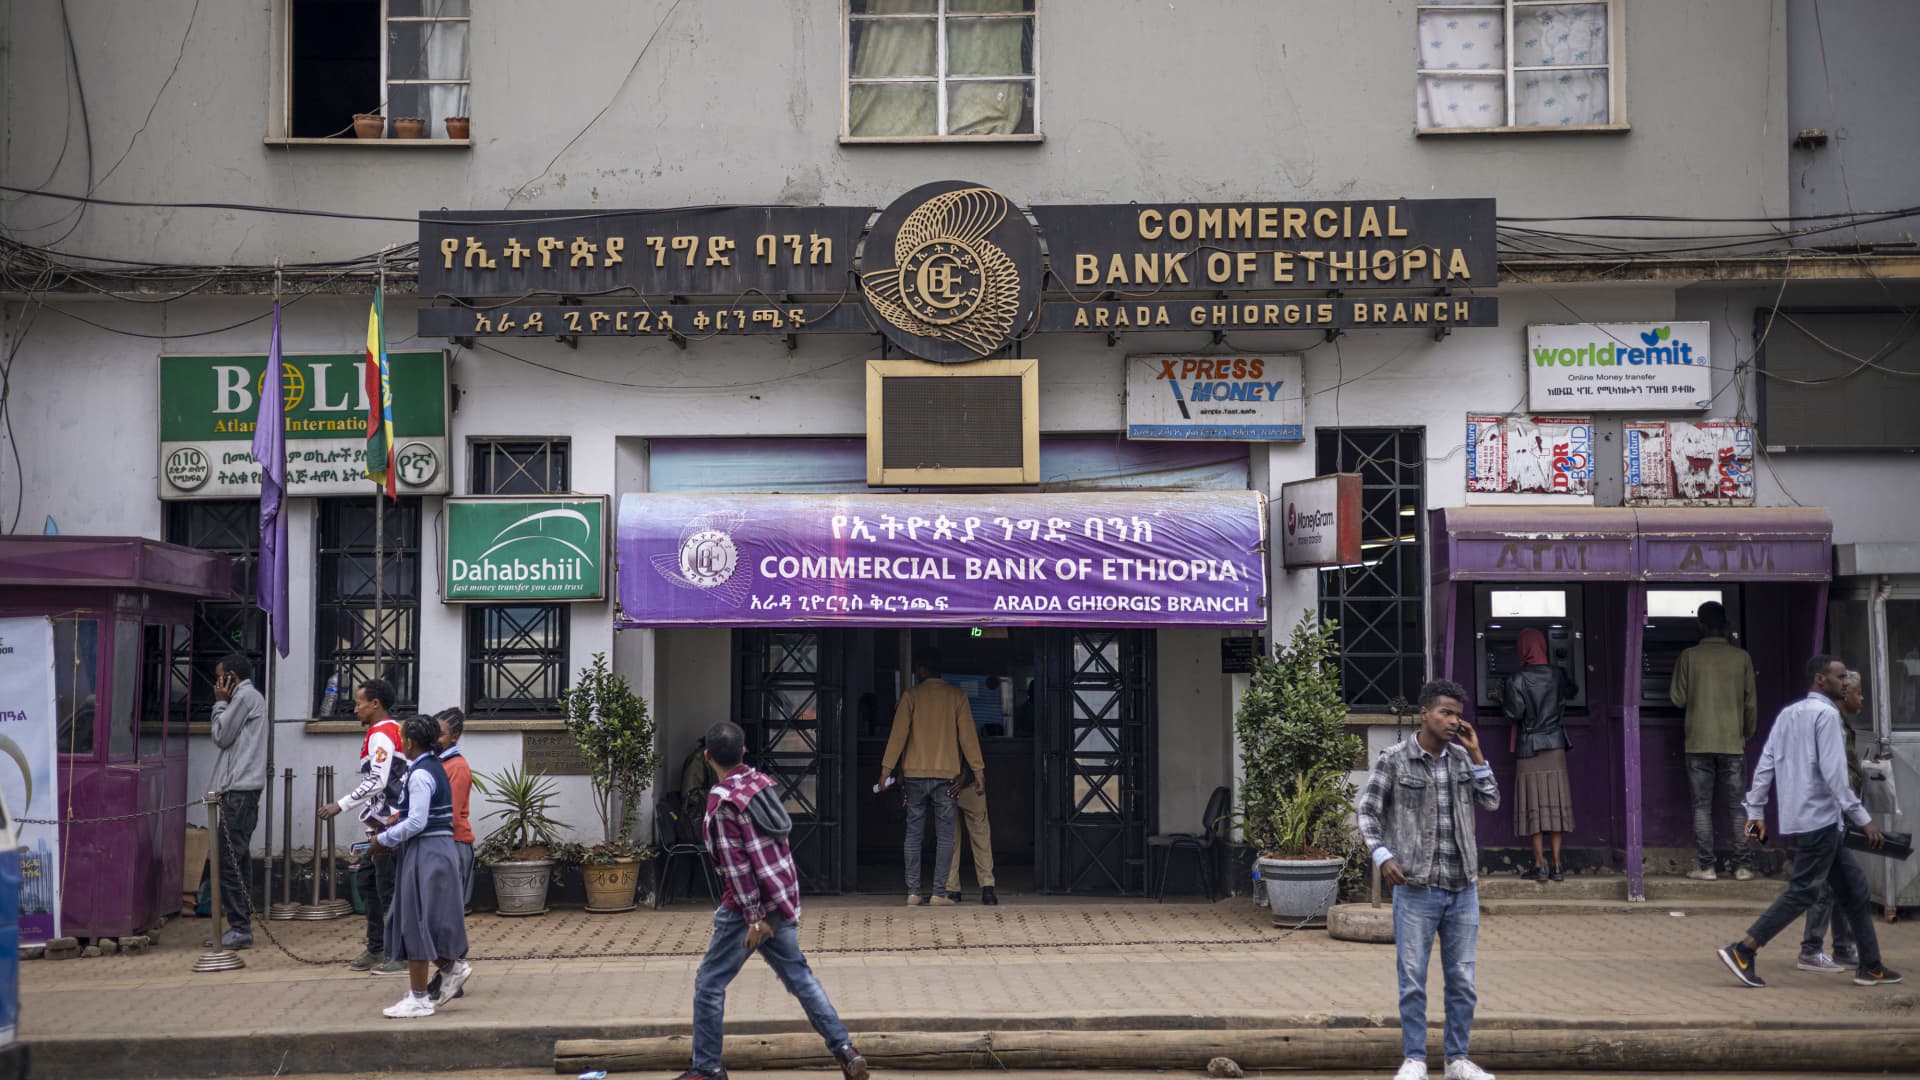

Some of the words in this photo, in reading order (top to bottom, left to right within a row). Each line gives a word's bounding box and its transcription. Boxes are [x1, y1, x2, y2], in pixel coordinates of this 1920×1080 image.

[1138, 205, 1408, 241] COMMERCIAL
[440, 236, 626, 270] የኢትዮጵያ
[646, 235, 736, 267] ንግድ
[755, 233, 833, 266] ባንክ
[1075, 252, 1189, 287] BANK
[1207, 251, 1258, 285] OF
[1273, 247, 1472, 284] ETHIOPIA
[474, 311, 544, 334] አራዳ
[562, 310, 673, 333] ጊዮርጊስ
[693, 308, 806, 331] ቅርንጫፍ
[1074, 306, 1171, 328] ARADA
[1190, 303, 1334, 326] GHIORGIS
[1353, 301, 1470, 323] BRANCH
[1532, 339, 1693, 367] worldremit
[1156, 358, 1265, 380] XPRESS
[1567, 373, 1595, 383] Online
[1595, 373, 1624, 384] Money
[1625, 372, 1657, 382] transfer
[1190, 380, 1285, 402] MONEY
[213, 417, 257, 434] Atlan
[285, 415, 368, 433] Internatio
[1630, 431, 1639, 458] future
[831, 513, 981, 543] የኢትዮጵያ
[993, 516, 1072, 543] ንግድ
[1084, 515, 1153, 543] ባንክ
[1297, 509, 1335, 532] MoneyGram
[759, 556, 956, 580] COMMERCIAL
[965, 557, 1046, 580] BANK
[1055, 558, 1092, 581] OF
[1103, 558, 1239, 582] ETHIOPIA
[1497, 542, 1588, 570] ATM
[1679, 544, 1775, 571] ATM
[452, 557, 583, 582] Dahabshiil
[453, 584, 469, 593] fast
[470, 585, 497, 593] money
[497, 583, 530, 593] transfer
[531, 585, 546, 593] you
[564, 583, 583, 591] trust
[750, 594, 792, 611] አራዳ
[870, 593, 949, 612] ቅርንጫፍ
[993, 595, 1062, 612] ARADA
[1067, 595, 1162, 613] GHIORGIS
[1167, 596, 1249, 613] BRANCH
